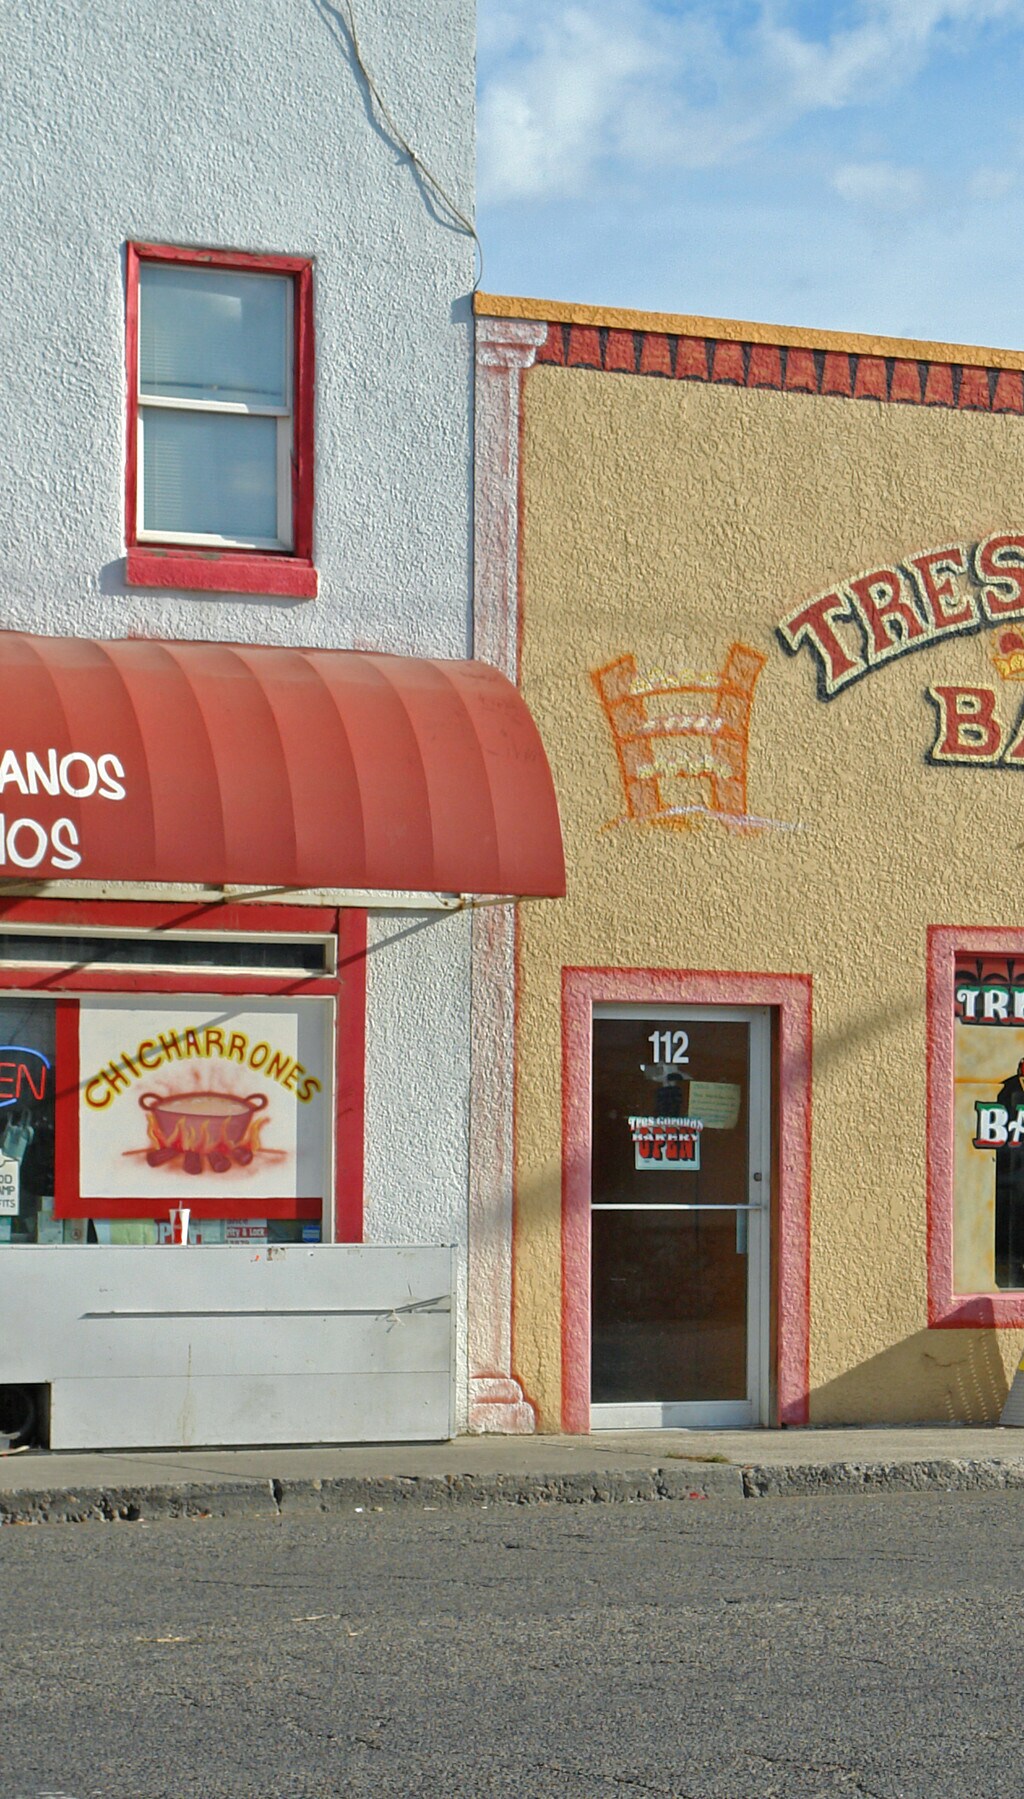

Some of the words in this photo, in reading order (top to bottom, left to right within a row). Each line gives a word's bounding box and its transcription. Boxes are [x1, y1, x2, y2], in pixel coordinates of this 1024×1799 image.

[0, 748, 126, 800] ANOS
[85, 1026, 322, 1110] CHICHARRONES
[648, 1030, 690, 1064] 112
